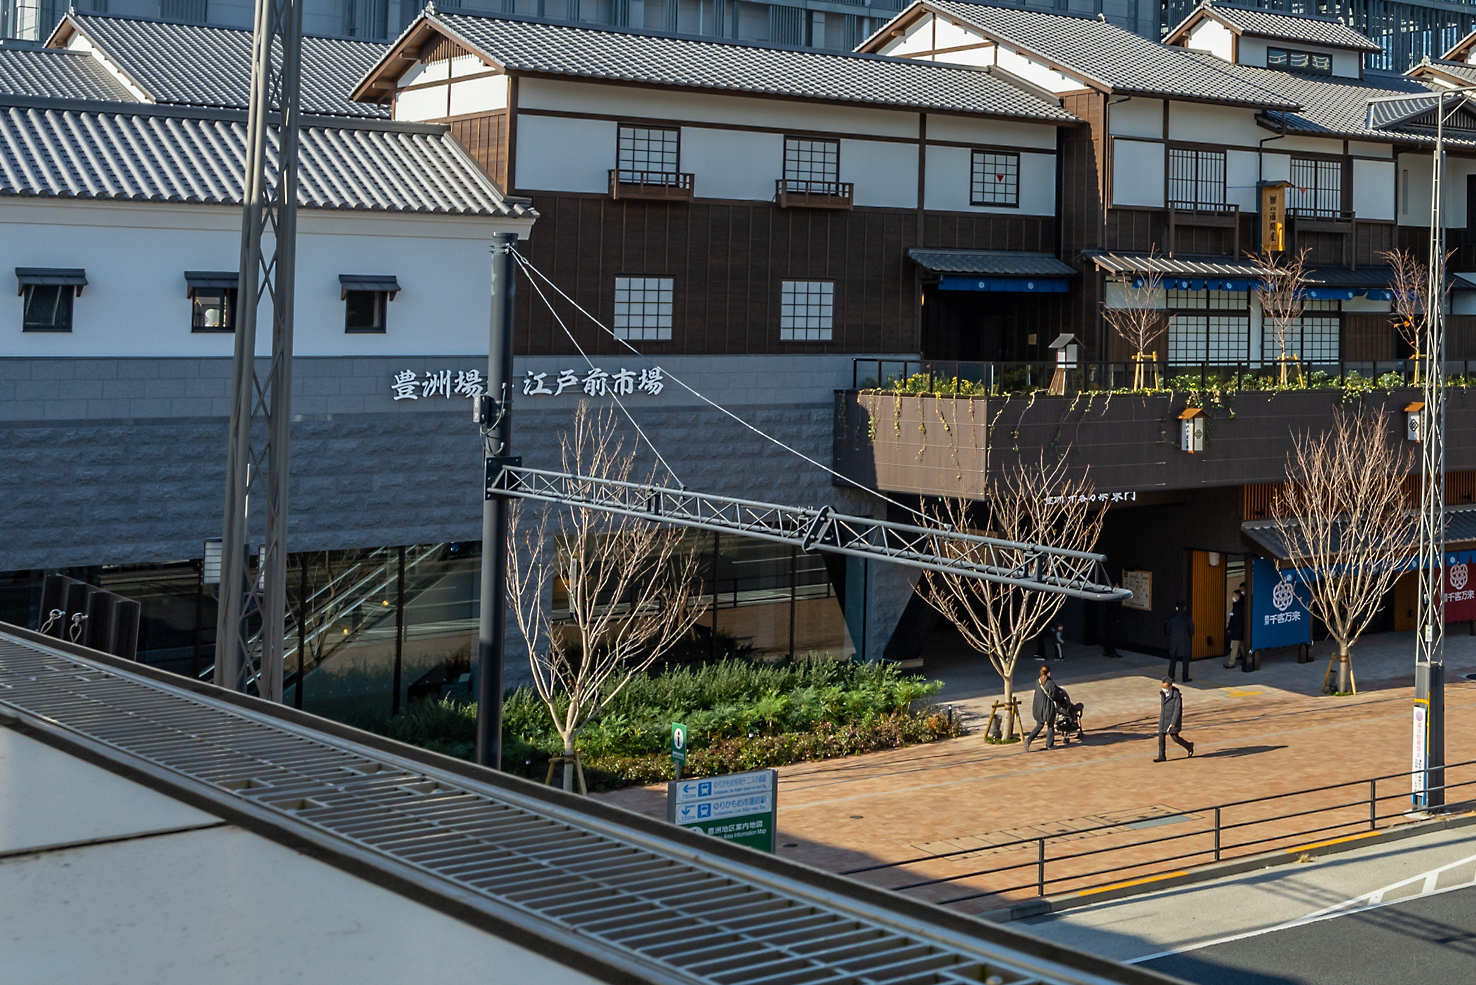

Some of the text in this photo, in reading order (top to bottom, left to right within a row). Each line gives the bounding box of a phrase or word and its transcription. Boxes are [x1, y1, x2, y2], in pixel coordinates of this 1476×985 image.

[391, 367, 664, 401] 豊洲場 江戸前市場
